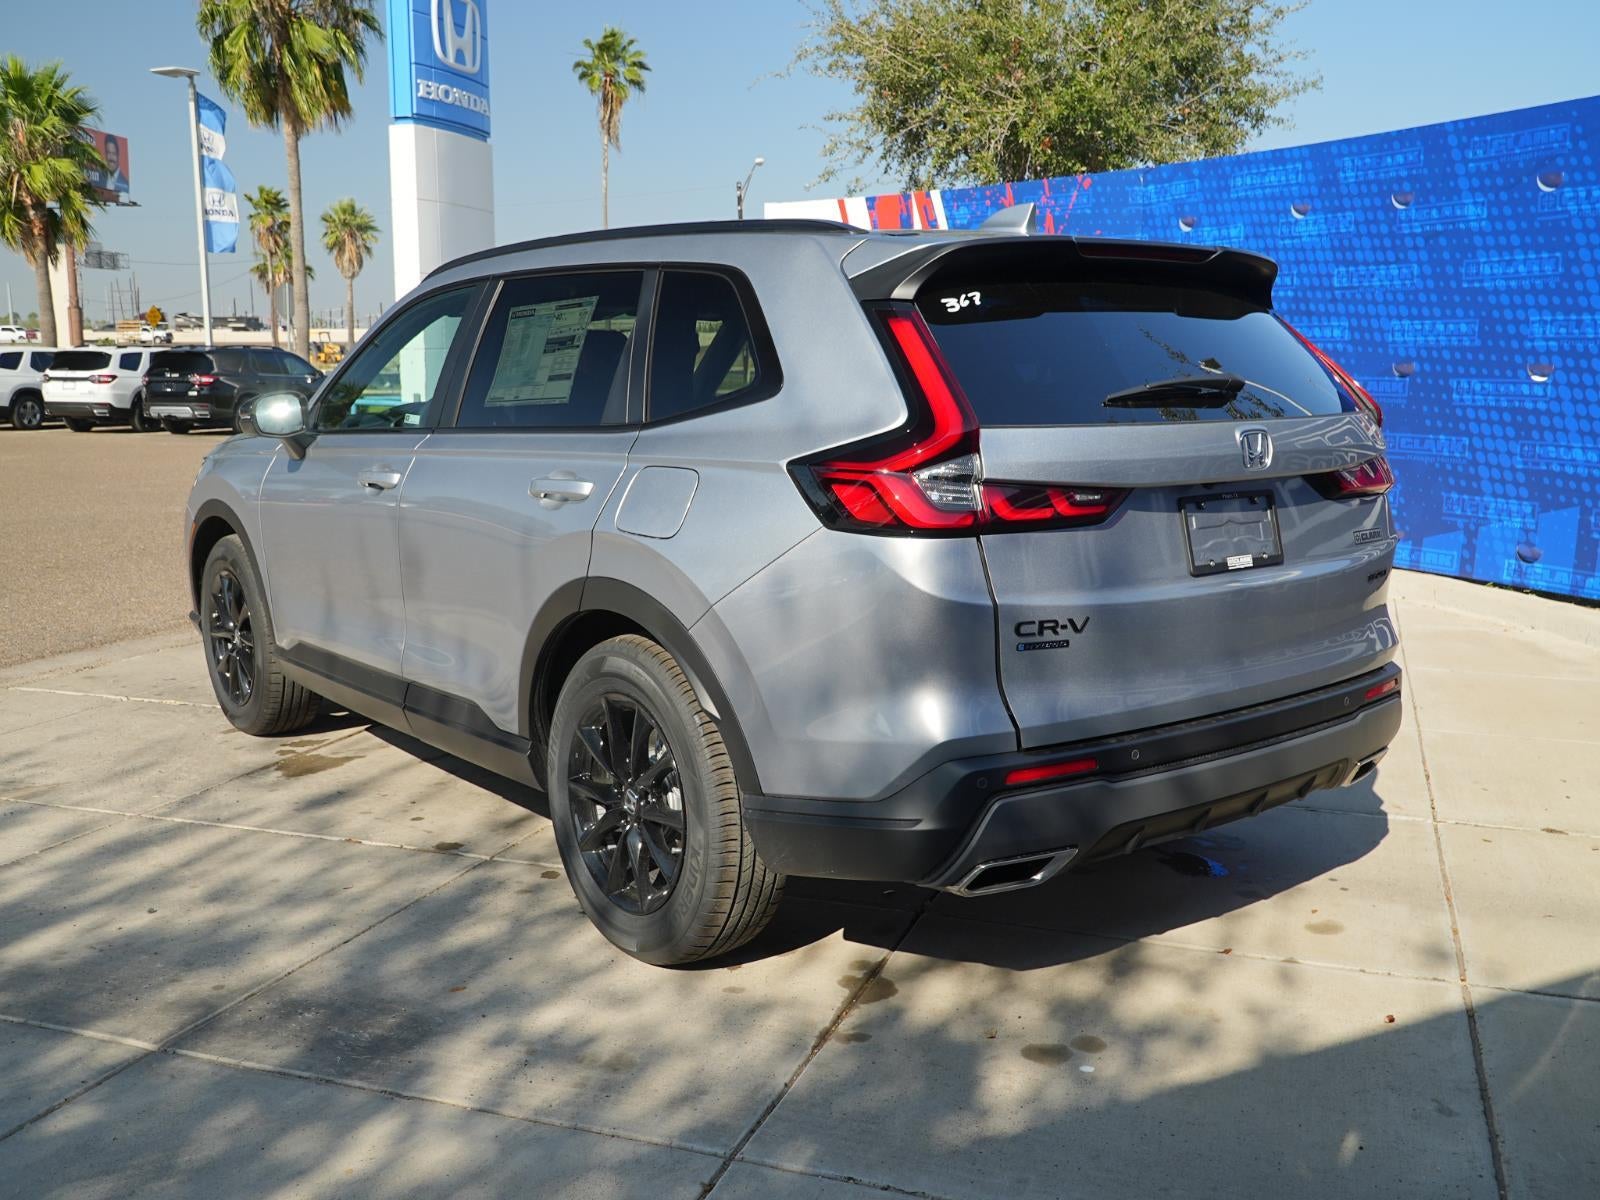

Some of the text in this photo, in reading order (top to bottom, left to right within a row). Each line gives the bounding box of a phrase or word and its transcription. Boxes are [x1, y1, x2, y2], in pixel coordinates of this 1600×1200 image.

[417, 79, 490, 118] HONDA
[940, 291, 982, 313] 367
[1400, 437, 1467, 456] CLARK
[1014, 616, 1090, 637] CR-V
